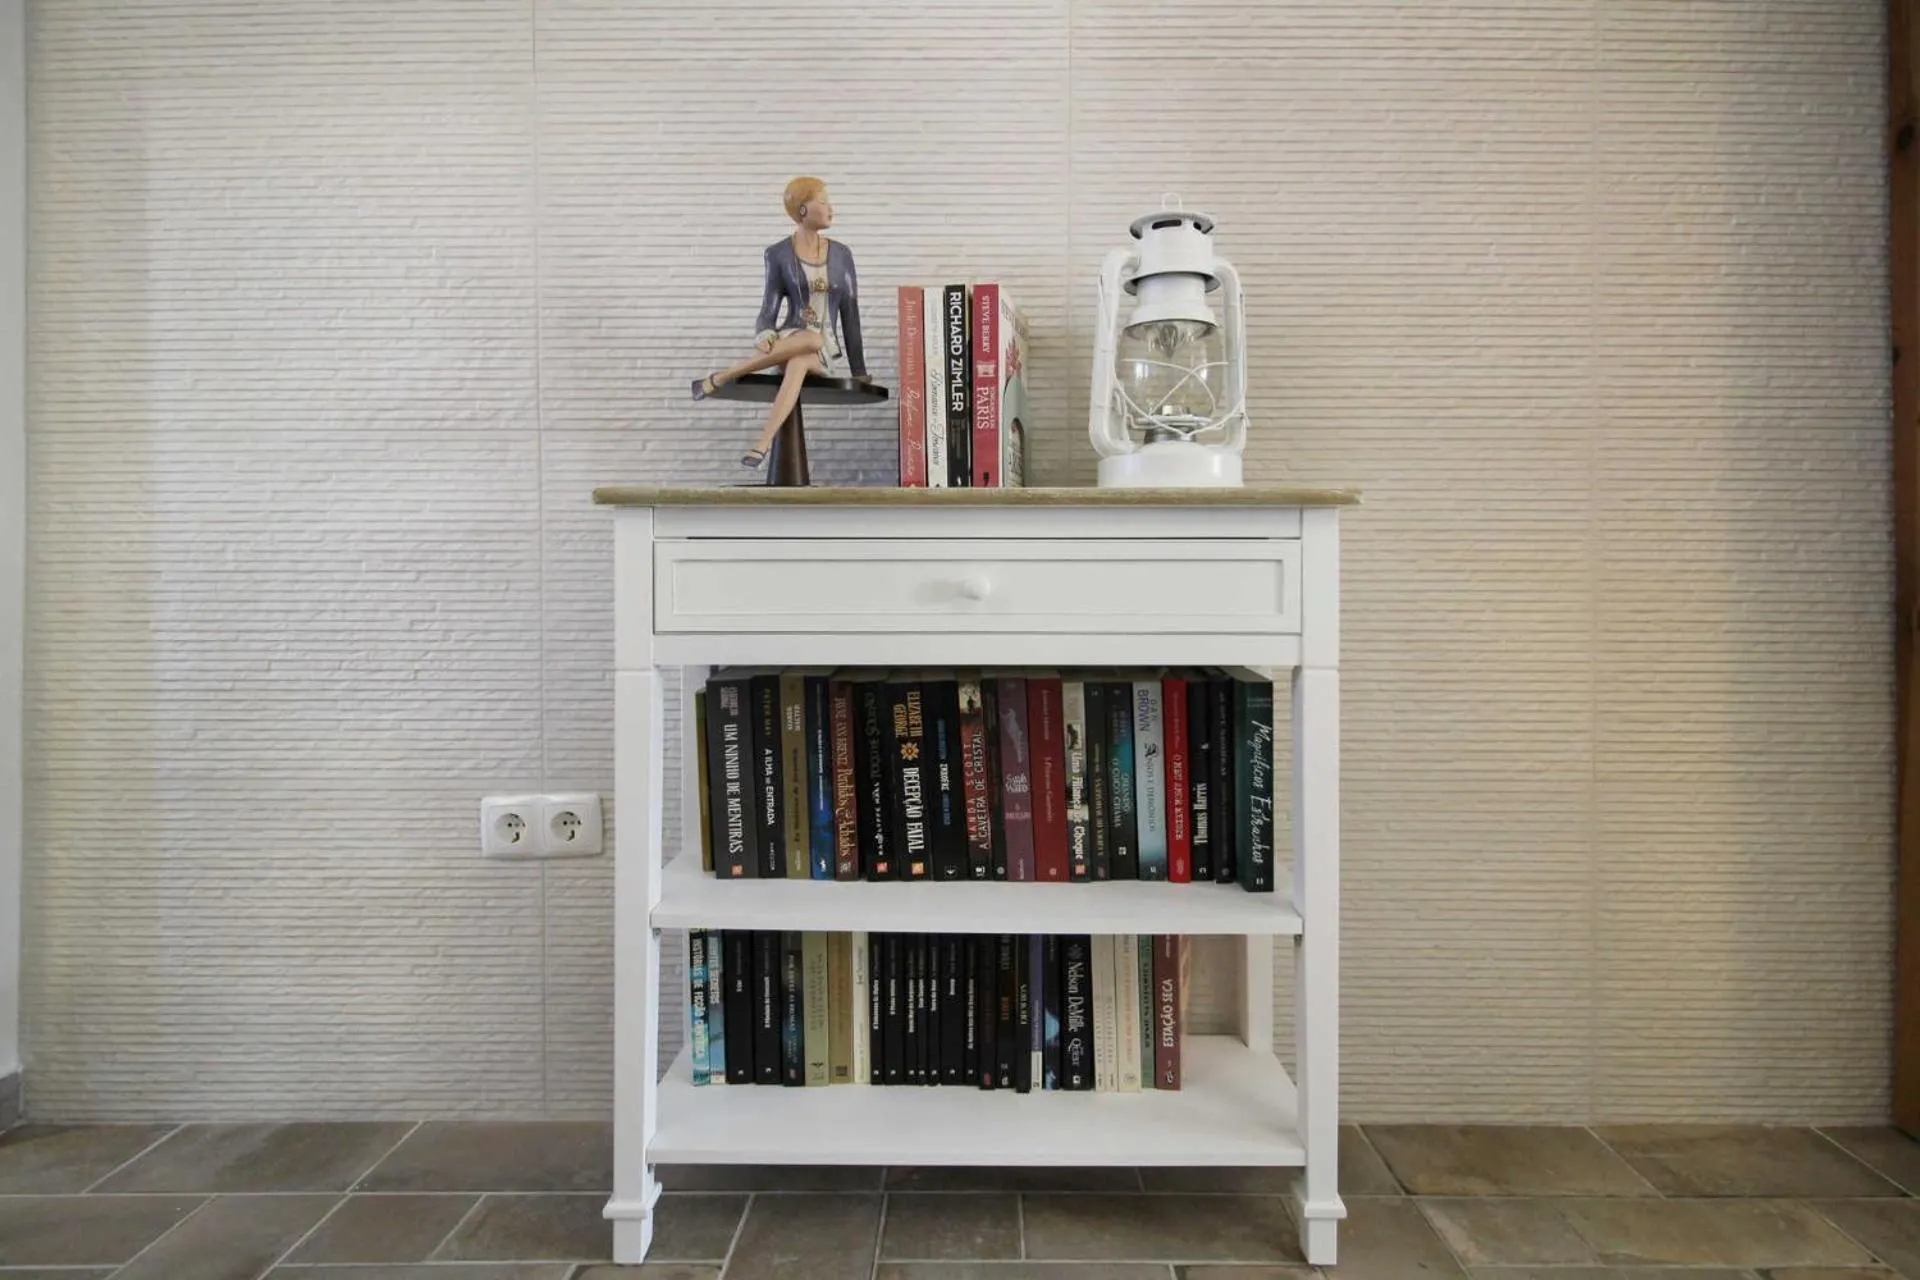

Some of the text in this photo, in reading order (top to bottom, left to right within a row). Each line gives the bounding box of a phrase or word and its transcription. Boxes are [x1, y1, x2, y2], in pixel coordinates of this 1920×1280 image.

[950, 292, 963, 356] RICHARD
[982, 295, 991, 353] STEVE BERRY
[951, 358, 964, 412] ZIMLER
[977, 387, 989, 429] PARIS
[893, 704, 909, 738] GEORGE
[907, 691, 924, 737] ELIZABETH
[1137, 689, 1150, 732] BROWN
[1149, 699, 1158, 721] DAN
[724, 723, 738, 741] UM
[973, 732, 984, 773] CRISTAL
[725, 745, 740, 779] NINHO
[1072, 752, 1082, 773] Uma
[1112, 767, 1120, 794] CUCO
[727, 782, 740, 795] DE
[766, 786, 775, 825] ENTRADA
[837, 768, 853, 806] Perdidos
[964, 743, 977, 841] MANDA SCOTT
[975, 779, 985, 791] DE
[1071, 776, 1083, 810] Aliança
[728, 798, 743, 854] MENTIRAS
[902, 768, 925, 853] DECEPÇÃO FATAL
[975, 797, 988, 838] CAVEIRA
[1113, 796, 1122, 829] CHAMA
[1192, 783, 1208, 845] Thomas Harris
[1250, 795, 1273, 863] Estranhos
[839, 820, 856, 857] Achados
[1073, 826, 1085, 860] Choque
[1067, 961, 1085, 1032] Nelson DeMille
[1160, 978, 1176, 1047] ESTAÇÃO SECA
